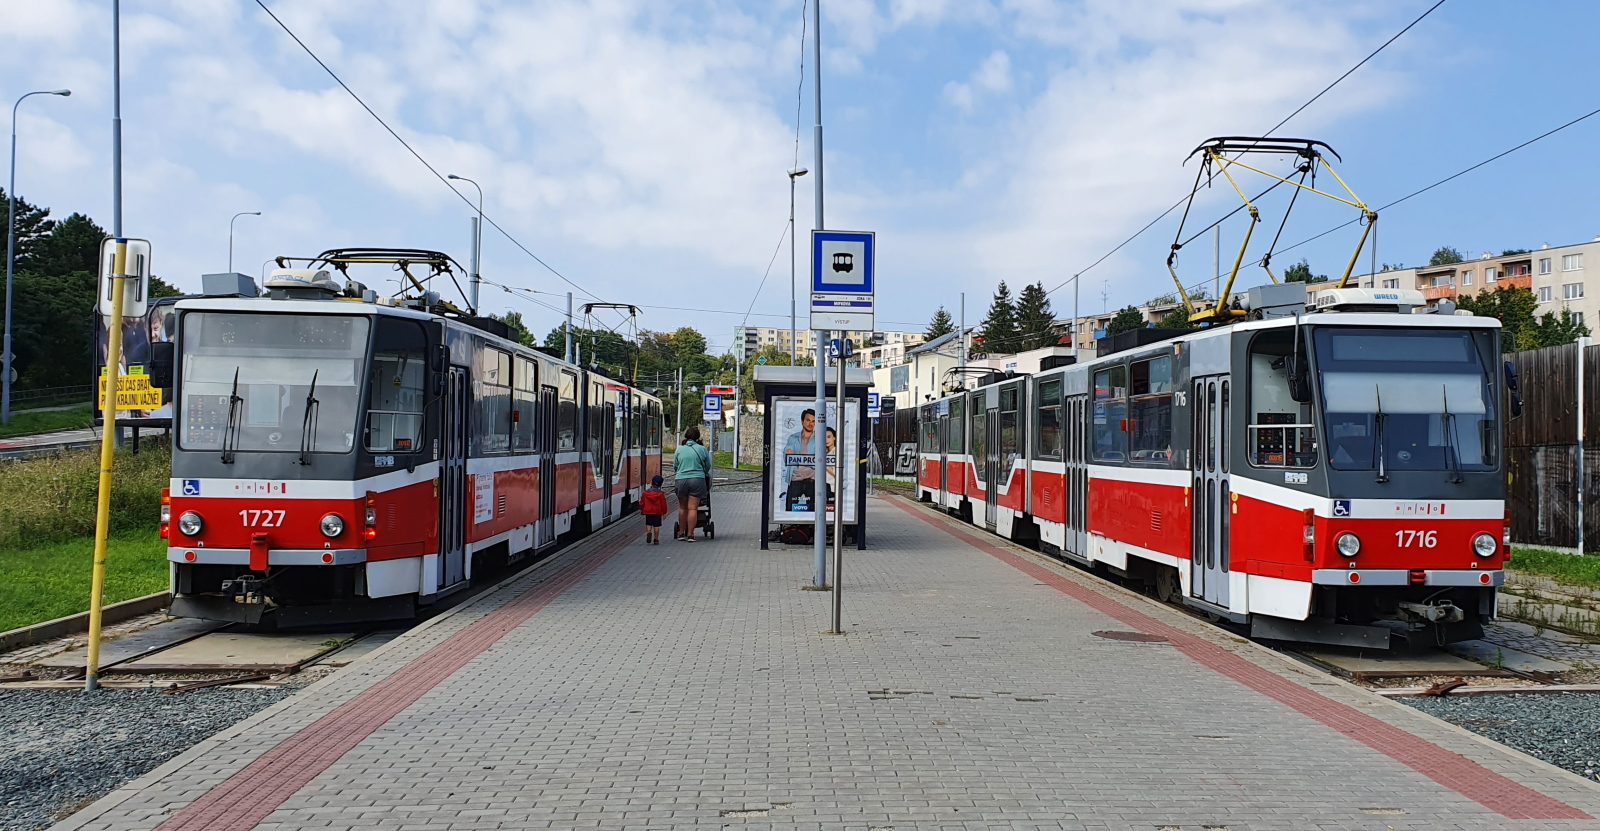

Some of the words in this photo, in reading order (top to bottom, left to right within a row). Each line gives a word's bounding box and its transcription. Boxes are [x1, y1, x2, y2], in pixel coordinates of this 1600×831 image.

[126, 377, 136, 391] ČAS
[137, 376, 150, 391] BRÁT
[116, 393, 139, 405] KRAJINU
[1175, 391, 1186, 406] 1716
[239, 510, 286, 527] 1727
[1395, 530, 1437, 548] 1716
